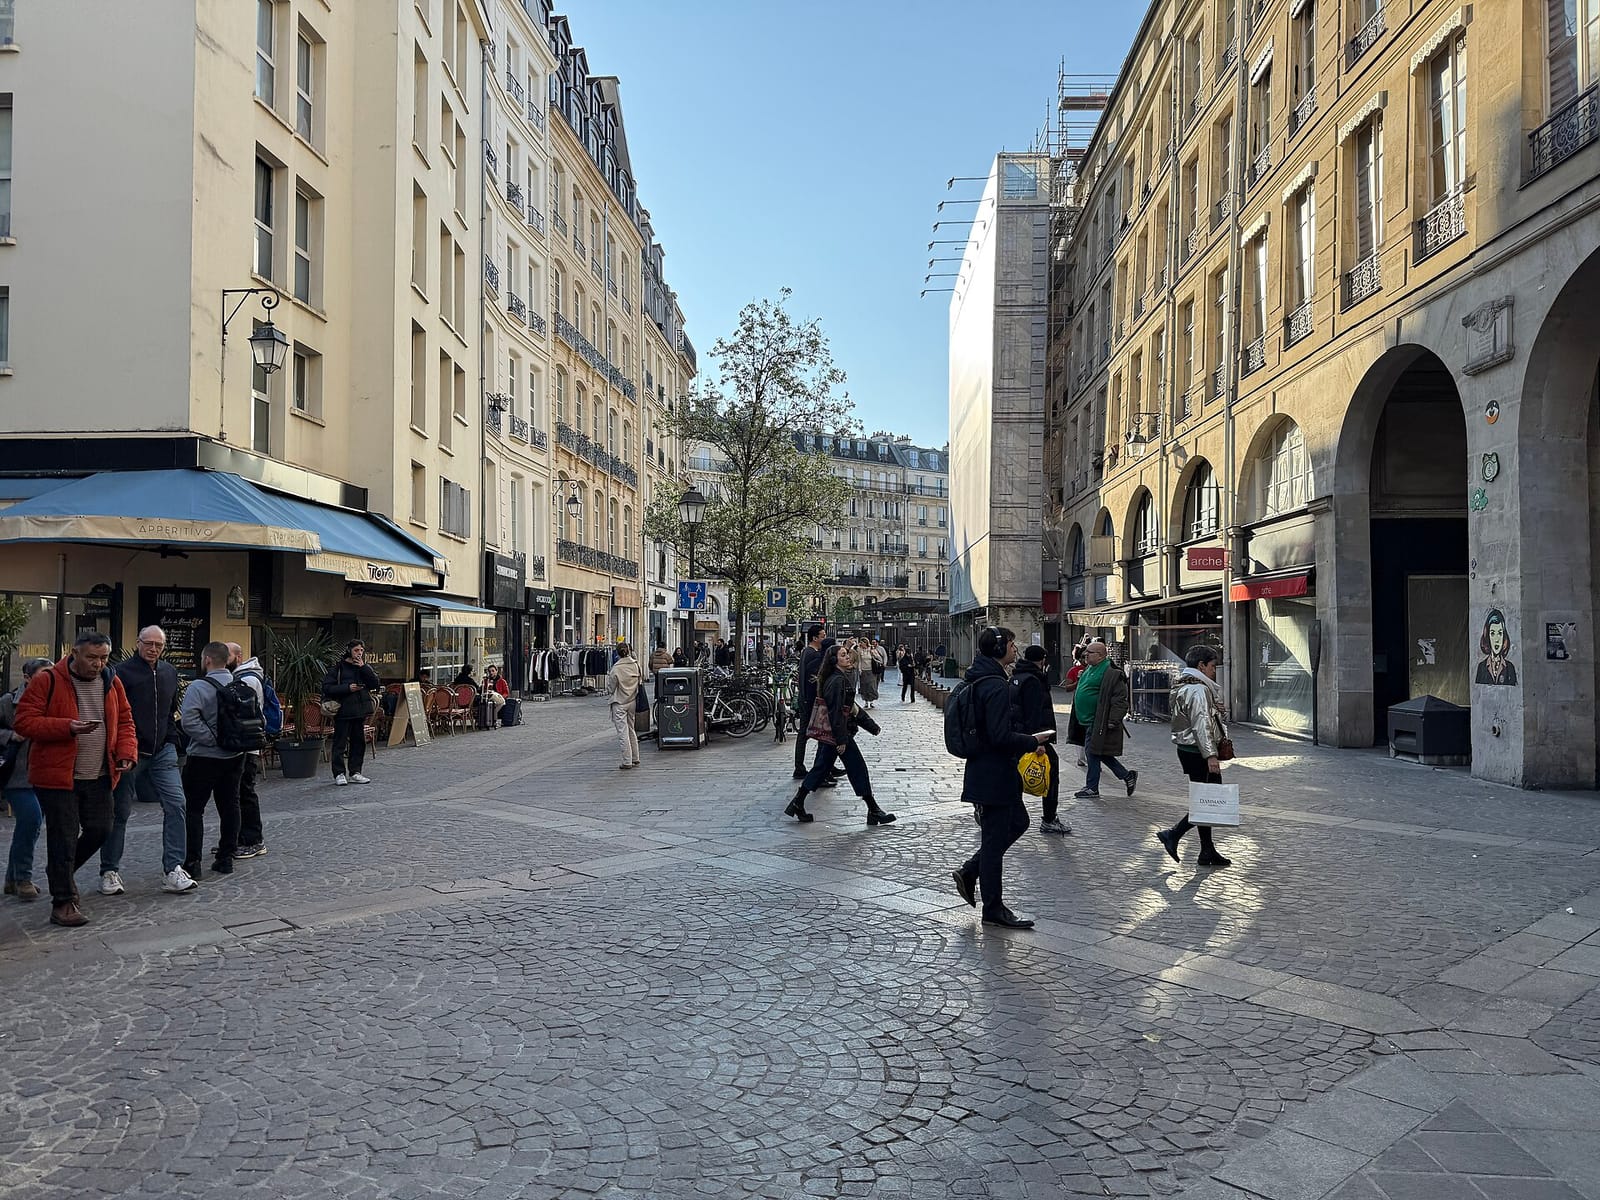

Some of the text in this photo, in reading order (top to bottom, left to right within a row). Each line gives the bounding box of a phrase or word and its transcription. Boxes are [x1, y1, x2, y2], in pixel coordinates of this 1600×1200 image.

[138, 524, 213, 537] APPERITIVO
[1190, 556, 1223, 566] arche
[772, 591, 782, 604] P
